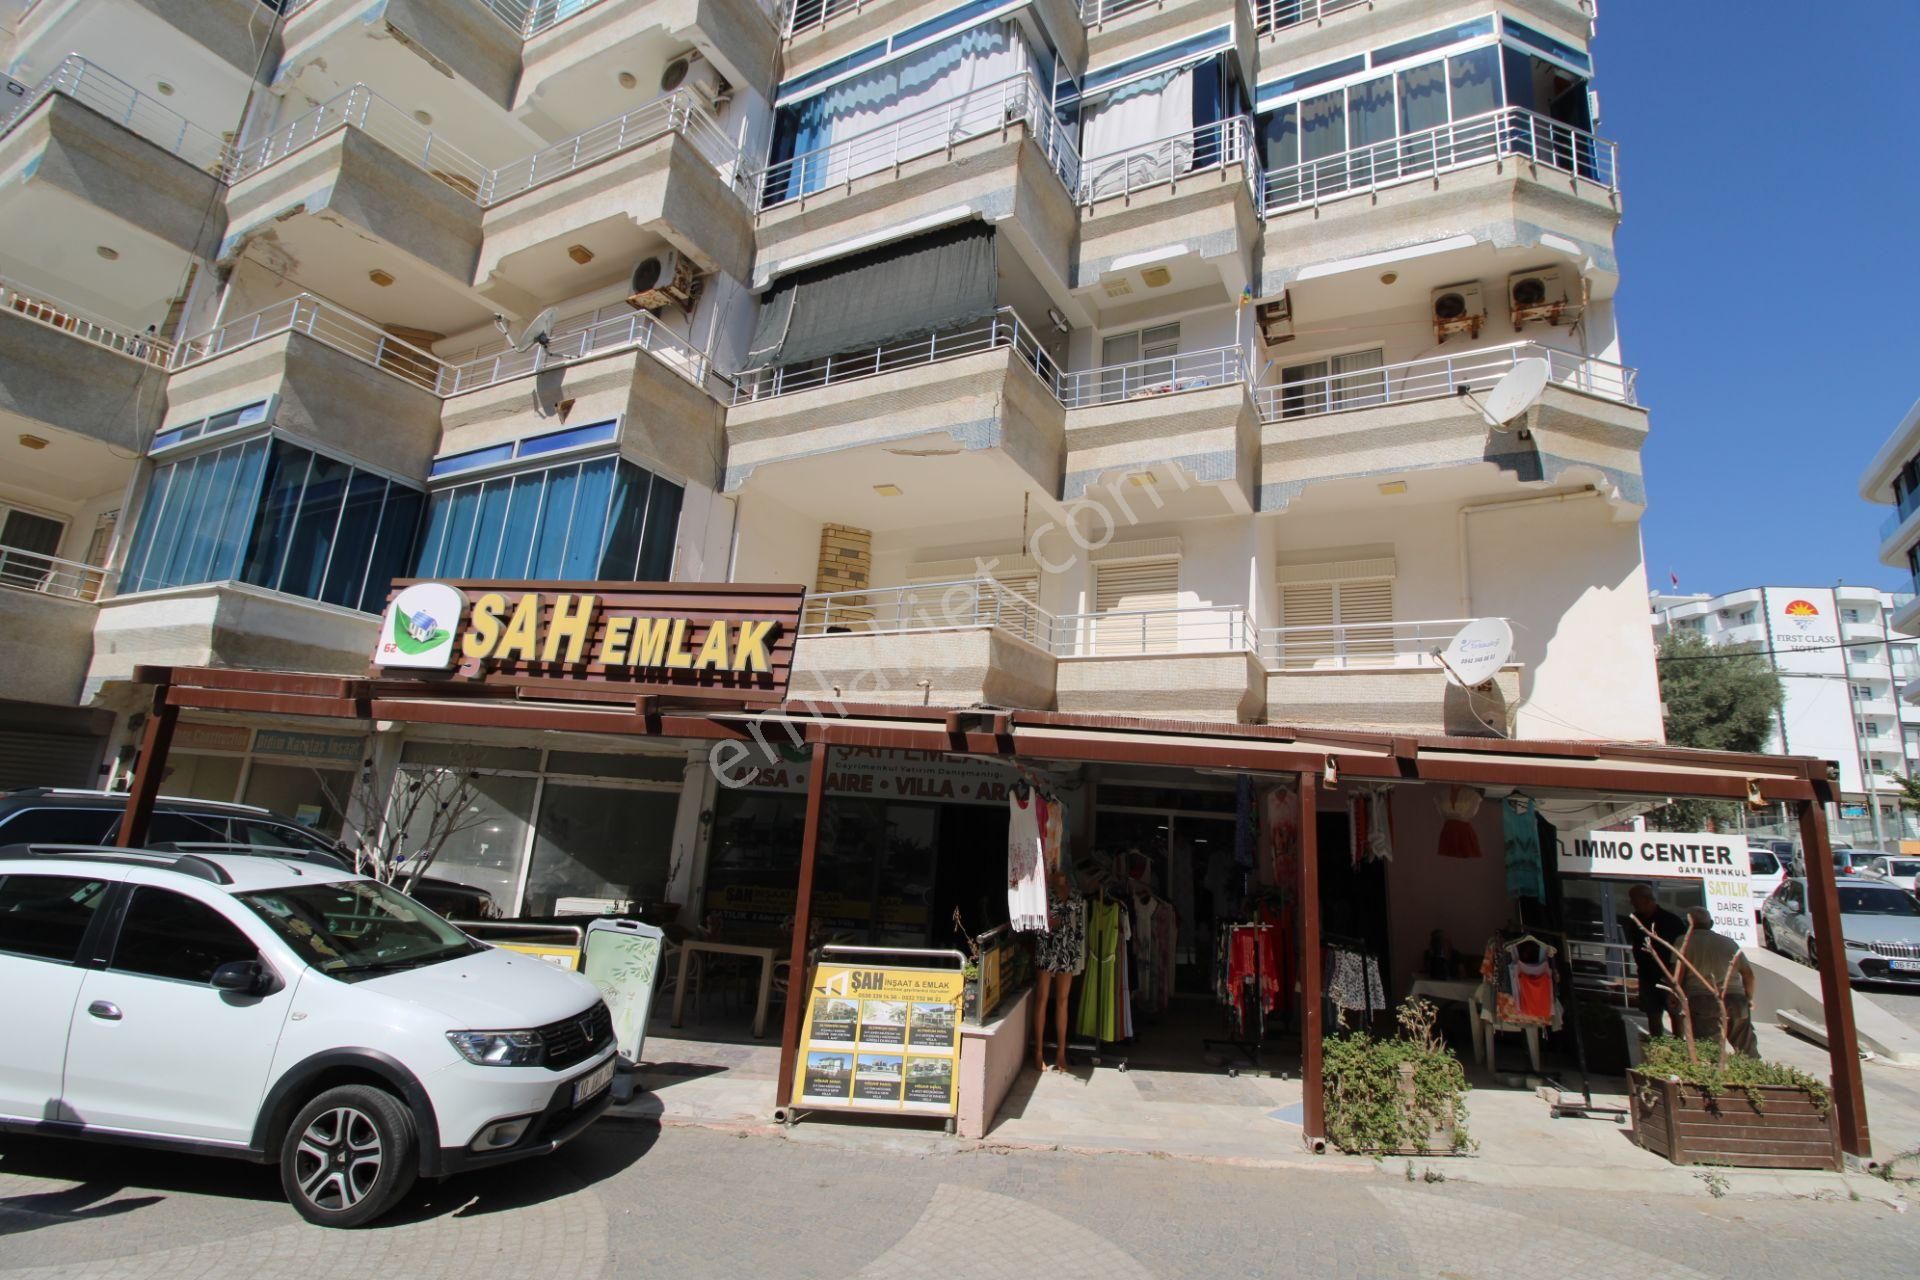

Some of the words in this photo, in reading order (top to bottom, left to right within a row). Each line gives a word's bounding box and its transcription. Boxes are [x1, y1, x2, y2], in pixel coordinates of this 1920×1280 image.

[599, 616, 777, 673] EMLAK
[1777, 634, 1803, 642] FIRST
[1804, 635, 1837, 644] CLASS
[1791, 645, 1825, 653] HOTEL
[1640, 842, 1733, 866] CENTER
[1708, 880, 1749, 898] SATILIK
[1714, 916, 1750, 927] DUBLEX
[851, 970, 884, 993] ŞAH
[922, 980, 950, 989] EMLAK
